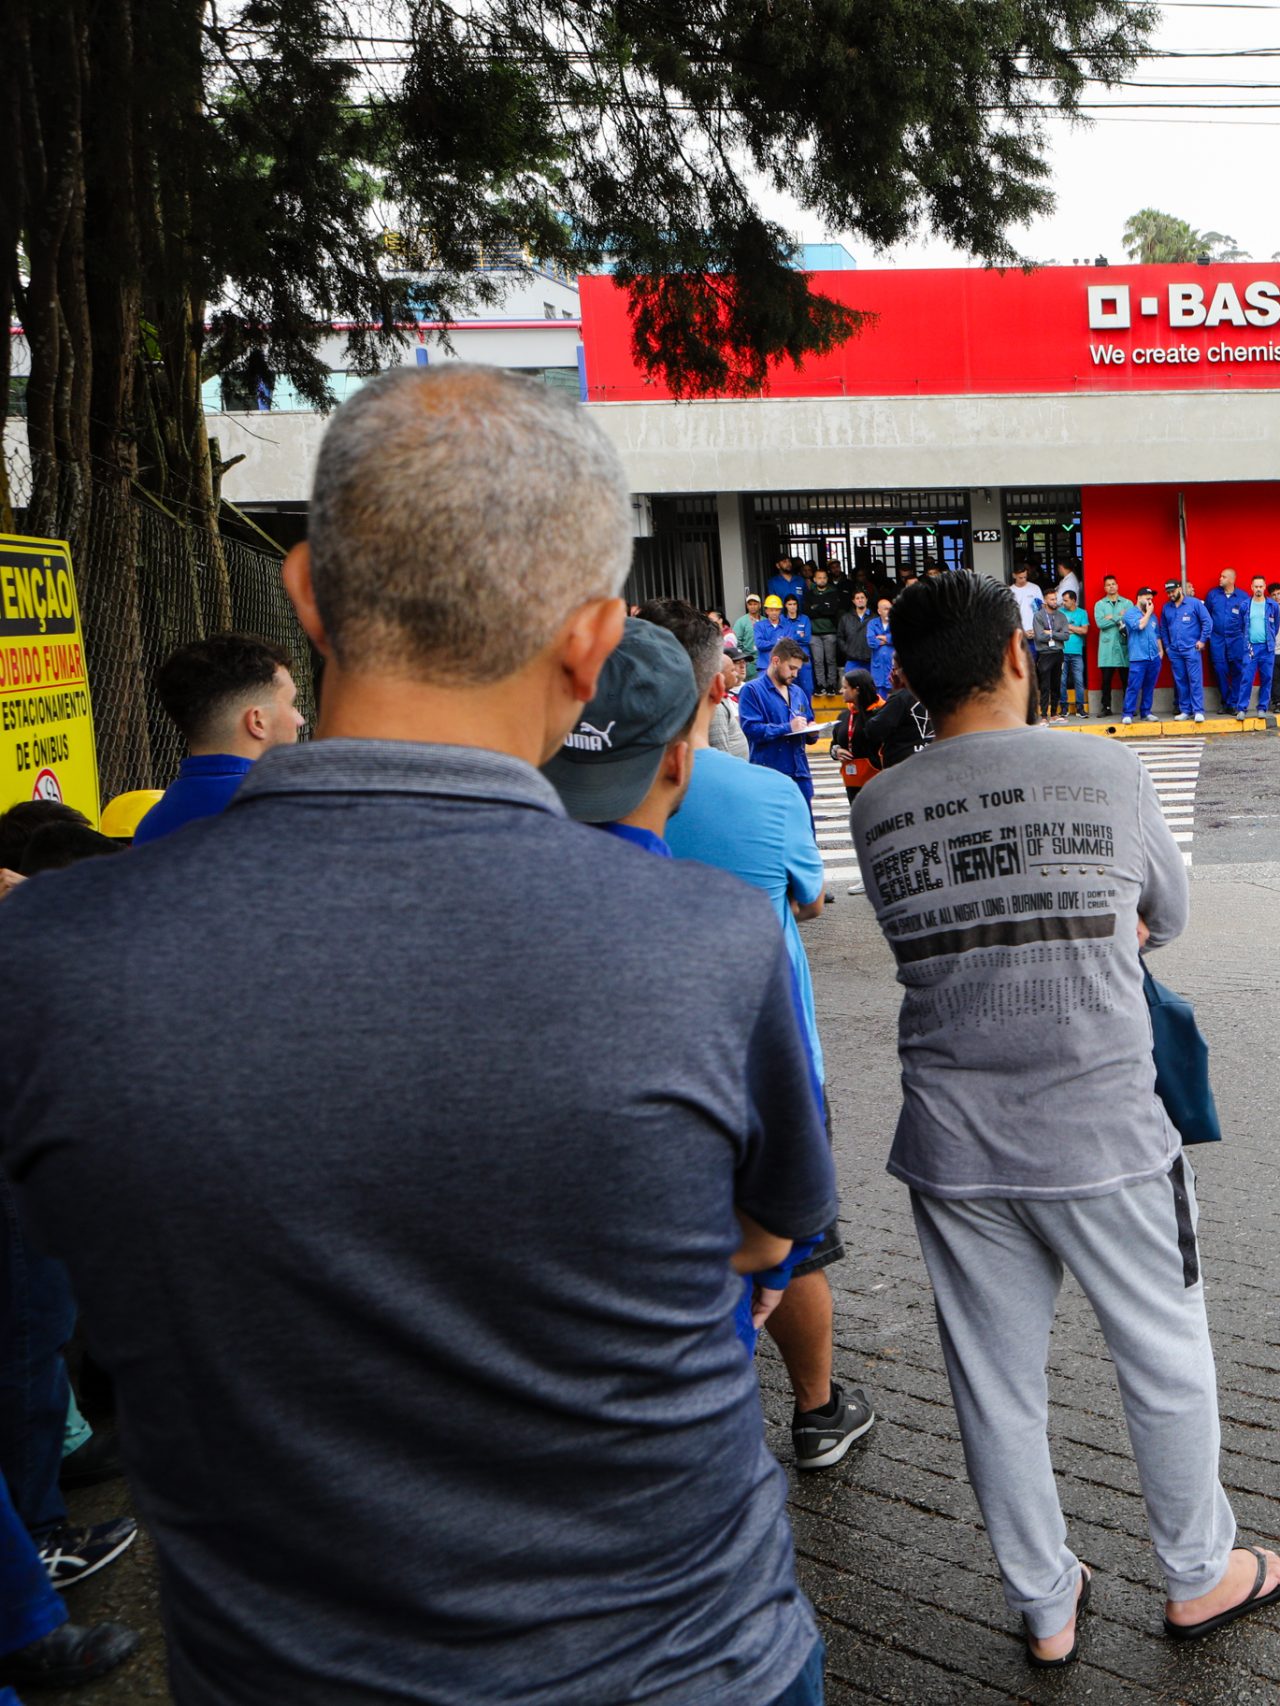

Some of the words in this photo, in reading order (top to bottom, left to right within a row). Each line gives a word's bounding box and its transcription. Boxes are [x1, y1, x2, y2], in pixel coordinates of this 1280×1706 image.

[1090, 344, 1125, 364] We
[1131, 344, 1200, 364] create
[977, 531, 998, 541] 123
[0, 556, 73, 633] ENÇÃO
[43, 643, 84, 682] FUMAR
[3, 690, 87, 731] ESTACIONAMENTO
[16, 741, 31, 771] DE
[32, 733, 69, 768] ÔNIBUS
[564, 732, 603, 751] UMA
[865, 811, 915, 846] SUMMER
[924, 798, 969, 821] ROCK
[979, 788, 1025, 809] TOUR
[1043, 785, 1110, 807] FEVER
[1025, 822, 1065, 838] CRAZY
[1072, 822, 1113, 840] NIGHTS
[948, 830, 993, 850] MADE
[1000, 826, 1017, 840] IN
[1027, 838, 1044, 856] OF
[1052, 838, 1114, 858] SUMMER
[951, 841, 1021, 885] HEAVEN
[938, 907, 953, 925] ALL
[953, 901, 980, 922] NIGHT
[981, 897, 1005, 917] LONG
[1011, 892, 1053, 914] BURNING
[1058, 891, 1079, 910] LOVE
